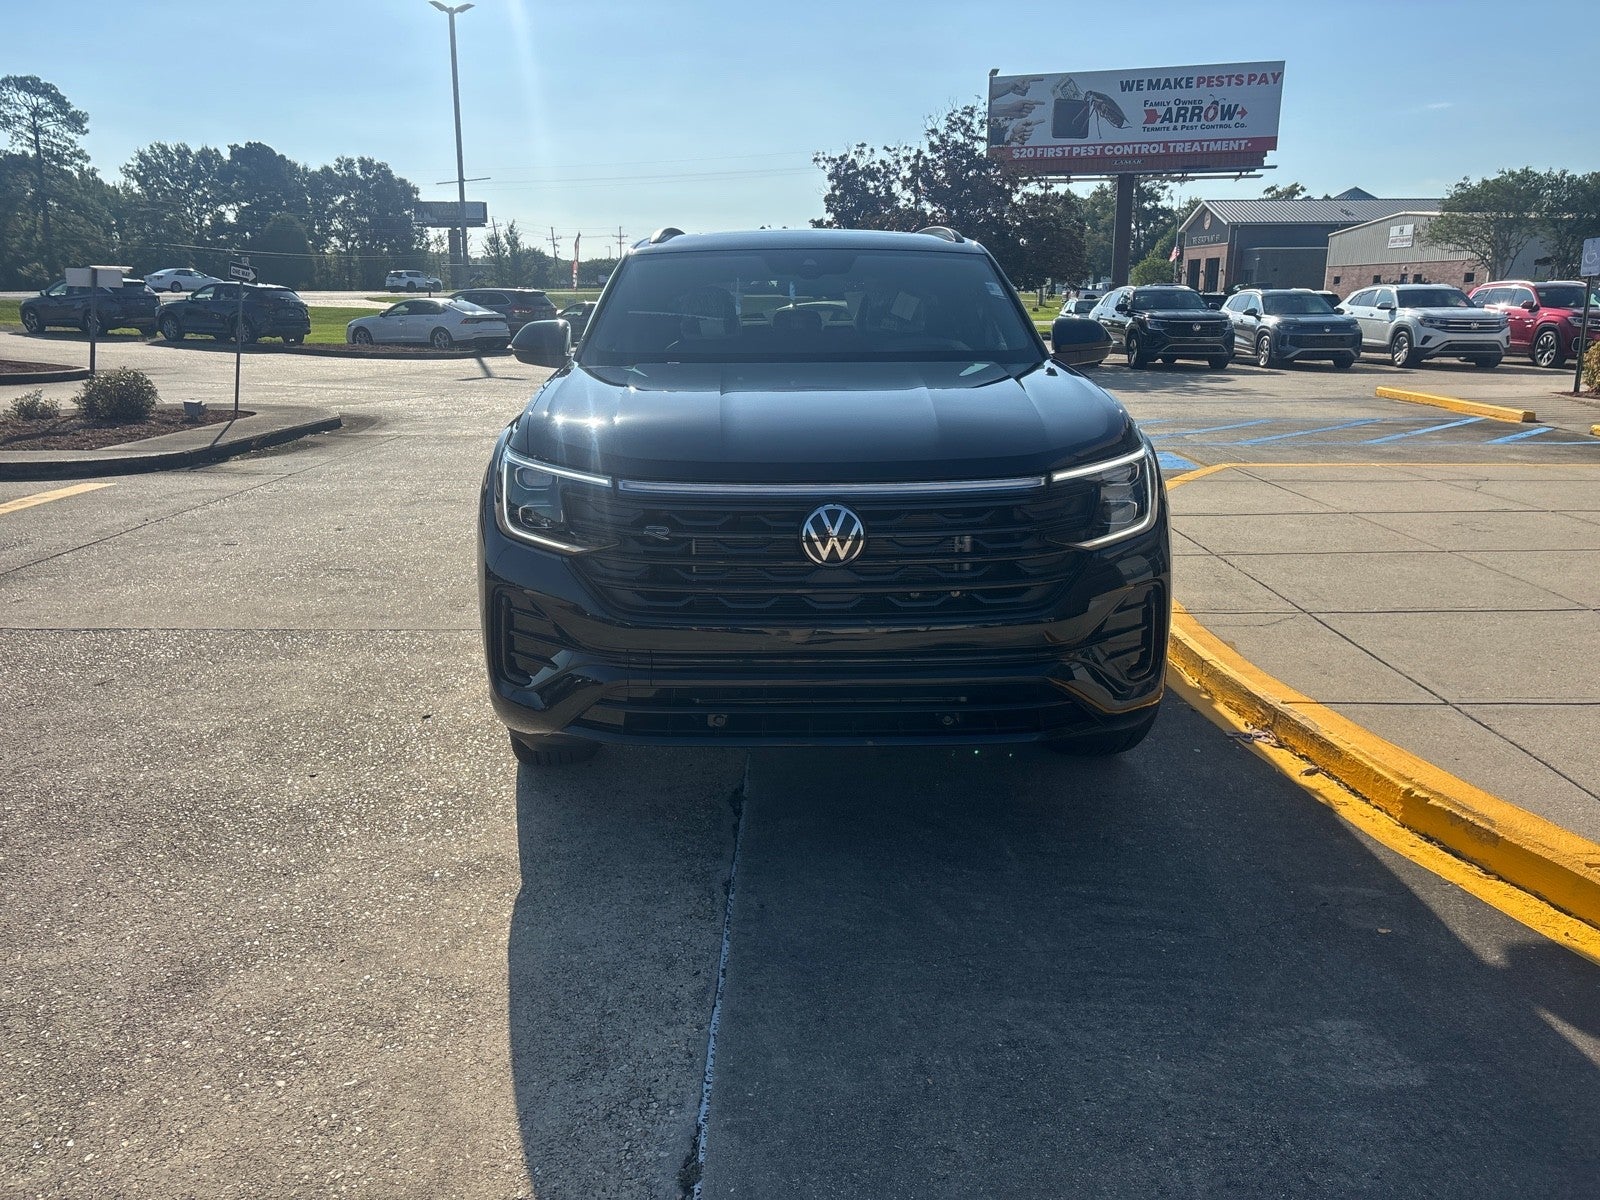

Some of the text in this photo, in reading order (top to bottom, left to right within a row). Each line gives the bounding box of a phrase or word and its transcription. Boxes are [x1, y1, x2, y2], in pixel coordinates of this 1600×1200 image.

[1119, 71, 1282, 92] WE MAKE PESTS PAY
[1160, 102, 1240, 124] ARROW
[1011, 148, 1034, 160] $20
[1036, 147, 1070, 158] FIRST
[1072, 145, 1103, 157] PEST
[1104, 143, 1166, 156] CONTROL
